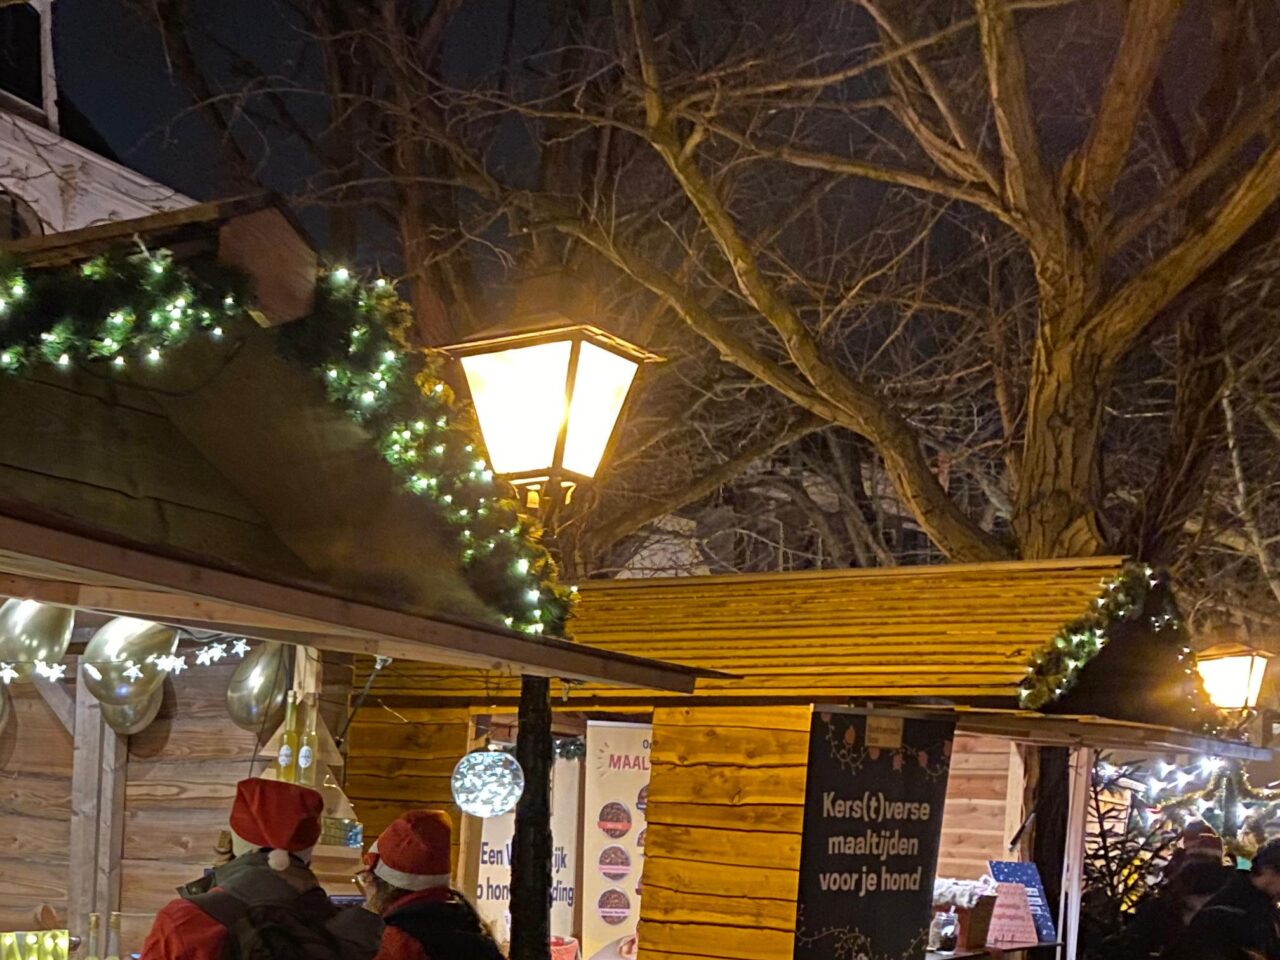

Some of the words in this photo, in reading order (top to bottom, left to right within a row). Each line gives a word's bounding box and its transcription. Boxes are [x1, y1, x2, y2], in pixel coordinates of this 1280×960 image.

[822, 791, 931, 822] Kers(t)verse
[480, 842, 503, 865] Een
[828, 829, 919, 861] maaltijden
[819, 872, 858, 891] voor
[859, 866, 877, 897] je
[881, 865, 922, 892] hond
